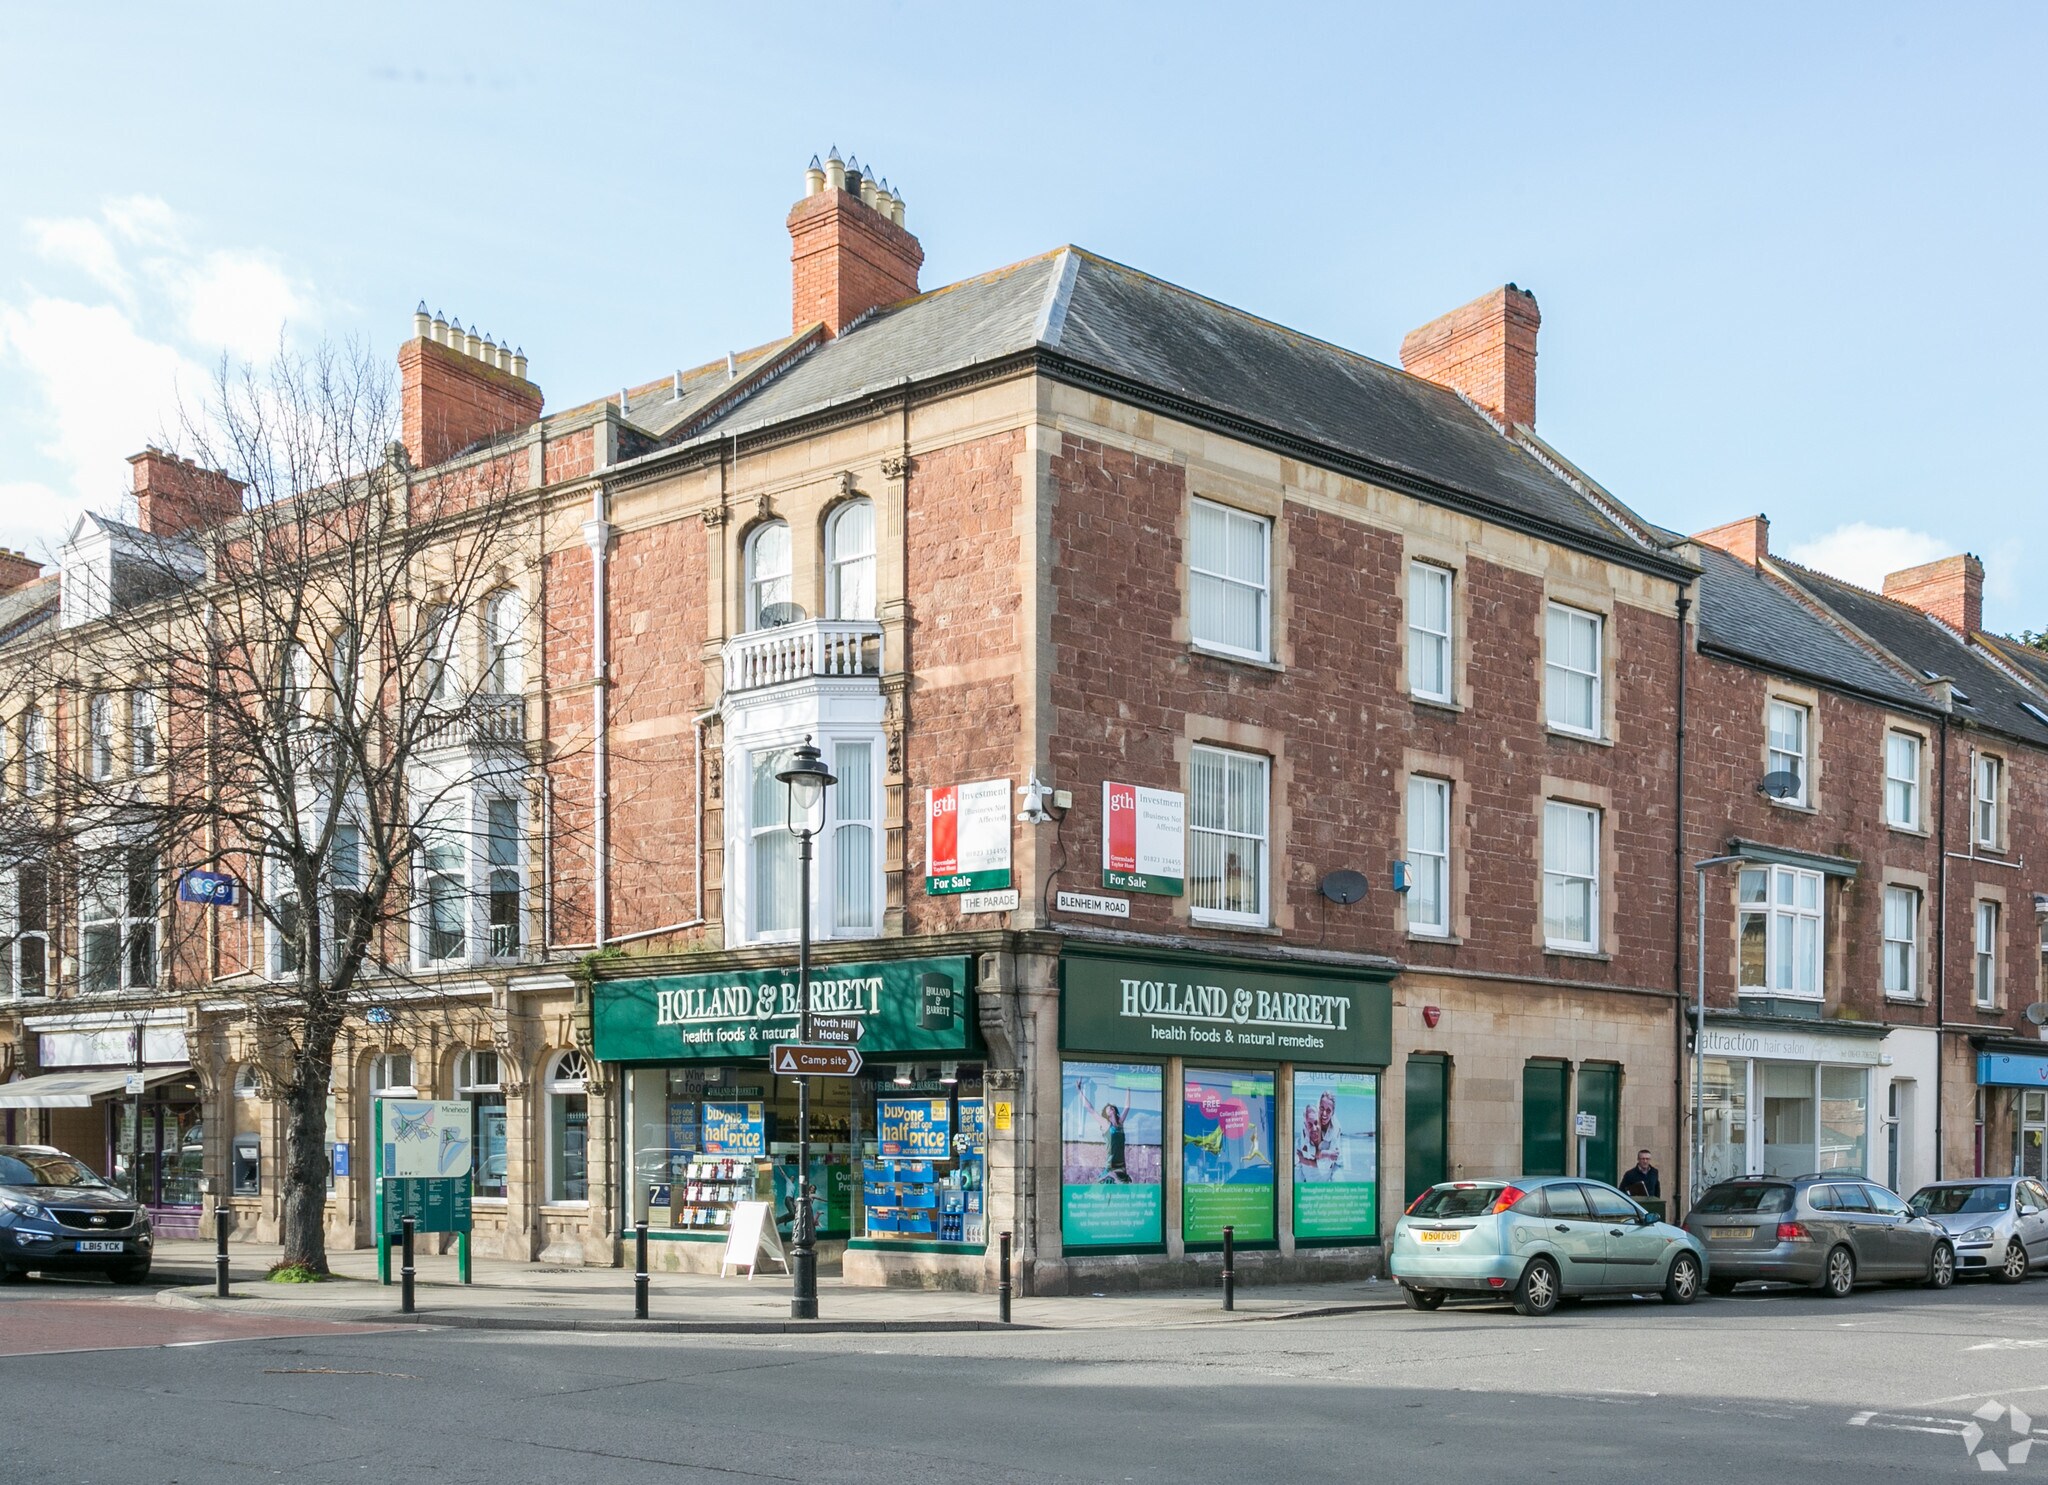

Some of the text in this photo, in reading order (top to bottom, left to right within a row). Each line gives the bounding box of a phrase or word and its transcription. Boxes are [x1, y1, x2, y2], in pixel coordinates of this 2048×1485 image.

[961, 787, 1006, 800] Investment
[933, 794, 956, 817] gth
[1111, 792, 1134, 811] gth
[1139, 793, 1182, 808] Investment
[933, 876, 972, 889] For Sale
[1109, 873, 1147, 888] For Sale
[965, 895, 1015, 908] THE PARADE
[1060, 896, 1126, 913] BLENHEIM ROAD
[926, 986, 950, 998] HOLLAND
[657, 984, 751, 1025] HOLLAND
[756, 983, 778, 1020] &
[926, 1005, 950, 1016] BARRETT
[1119, 978, 1350, 1030] HOLLAND & BARRETT
[813, 1017, 856, 1029] North Hill
[683, 1023, 800, 1044] health foods & natural
[819, 1030, 849, 1041] Hotels
[1151, 1024, 1324, 1049] health foods & natural remedies
[1702, 1032, 1805, 1055] attraction hair salon
[801, 1055, 848, 1065] Camp site
[441, 1105, 469, 1113] Minehead
[961, 1105, 975, 1115] buy
[1202, 1100, 1220, 1108] FREE
[707, 1105, 742, 1124] buy one
[884, 1103, 924, 1122] buy one
[961, 1115, 974, 1123] get
[921, 1121, 932, 1129] one
[962, 1123, 975, 1132] half
[1225, 1122, 1244, 1130] purchase
[675, 1130, 694, 1142] price
[705, 1124, 760, 1147] half price
[882, 1122, 909, 1141] half
[909, 1129, 945, 1147] price
[836, 1171, 851, 1181] Our
[649, 1185, 661, 1204] 7
[82, 1242, 120, 1250] LB15 YCK
